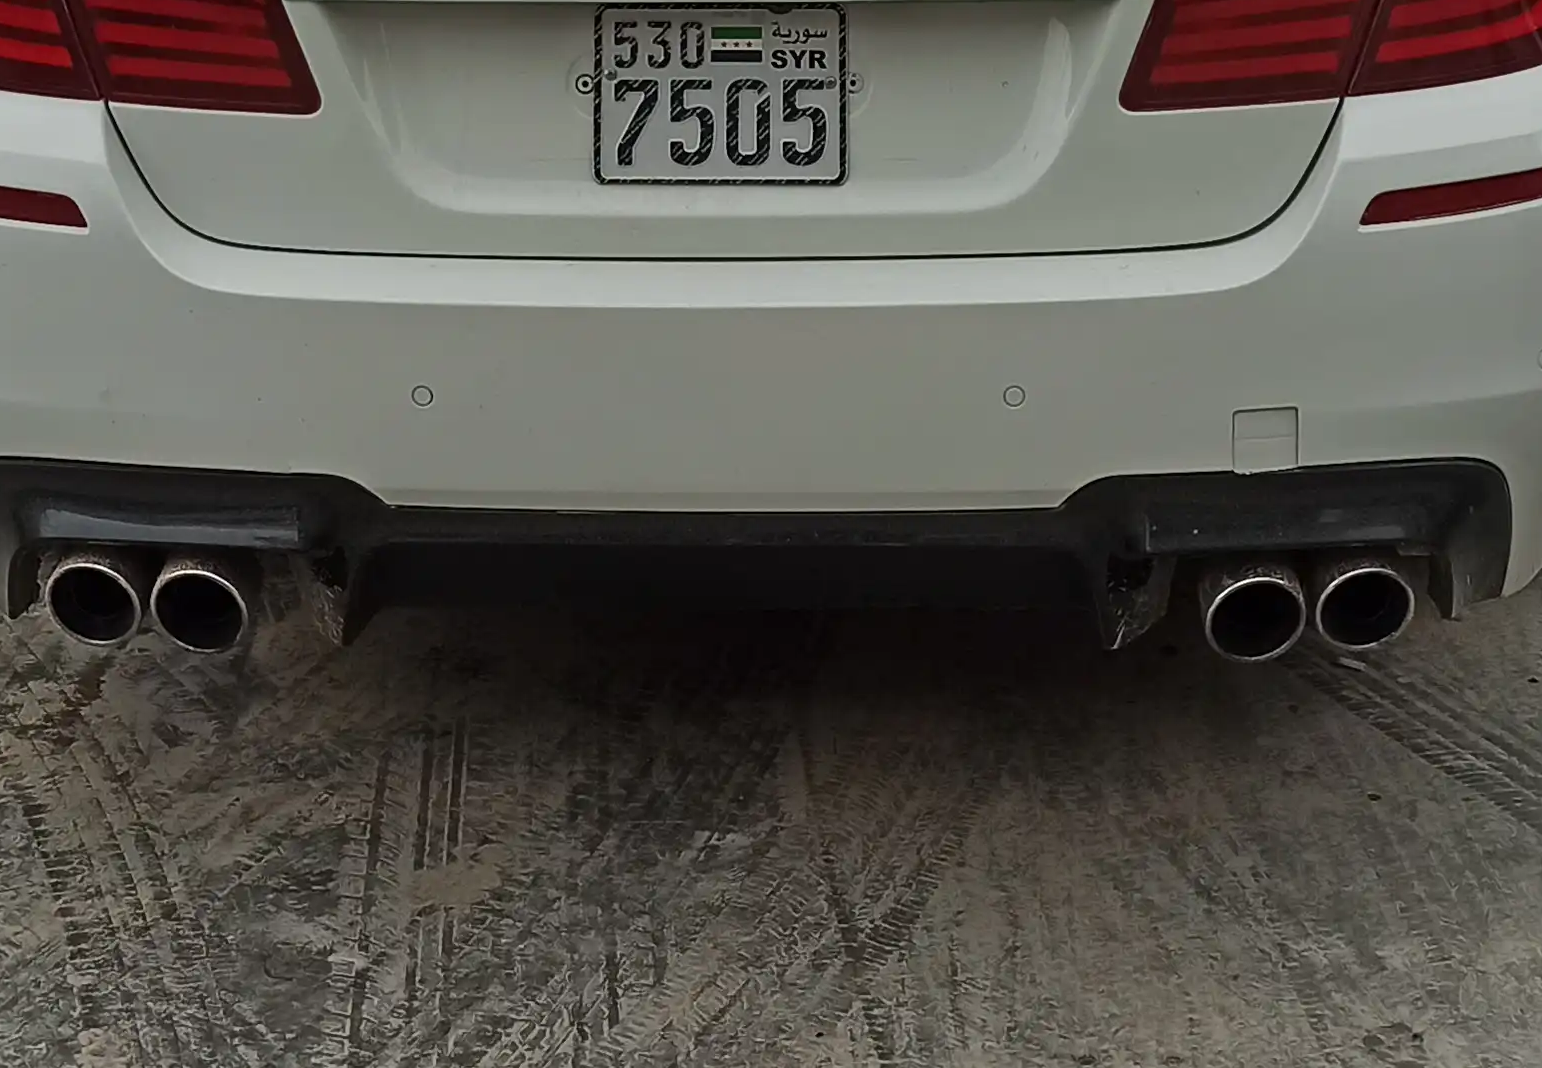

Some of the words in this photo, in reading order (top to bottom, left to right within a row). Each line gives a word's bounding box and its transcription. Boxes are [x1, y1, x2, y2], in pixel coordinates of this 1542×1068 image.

[614, 21, 705, 69] 530
[770, 20, 828, 45] سورية
[770, 49, 828, 69] SYR
[614, 78, 827, 167] 7505
